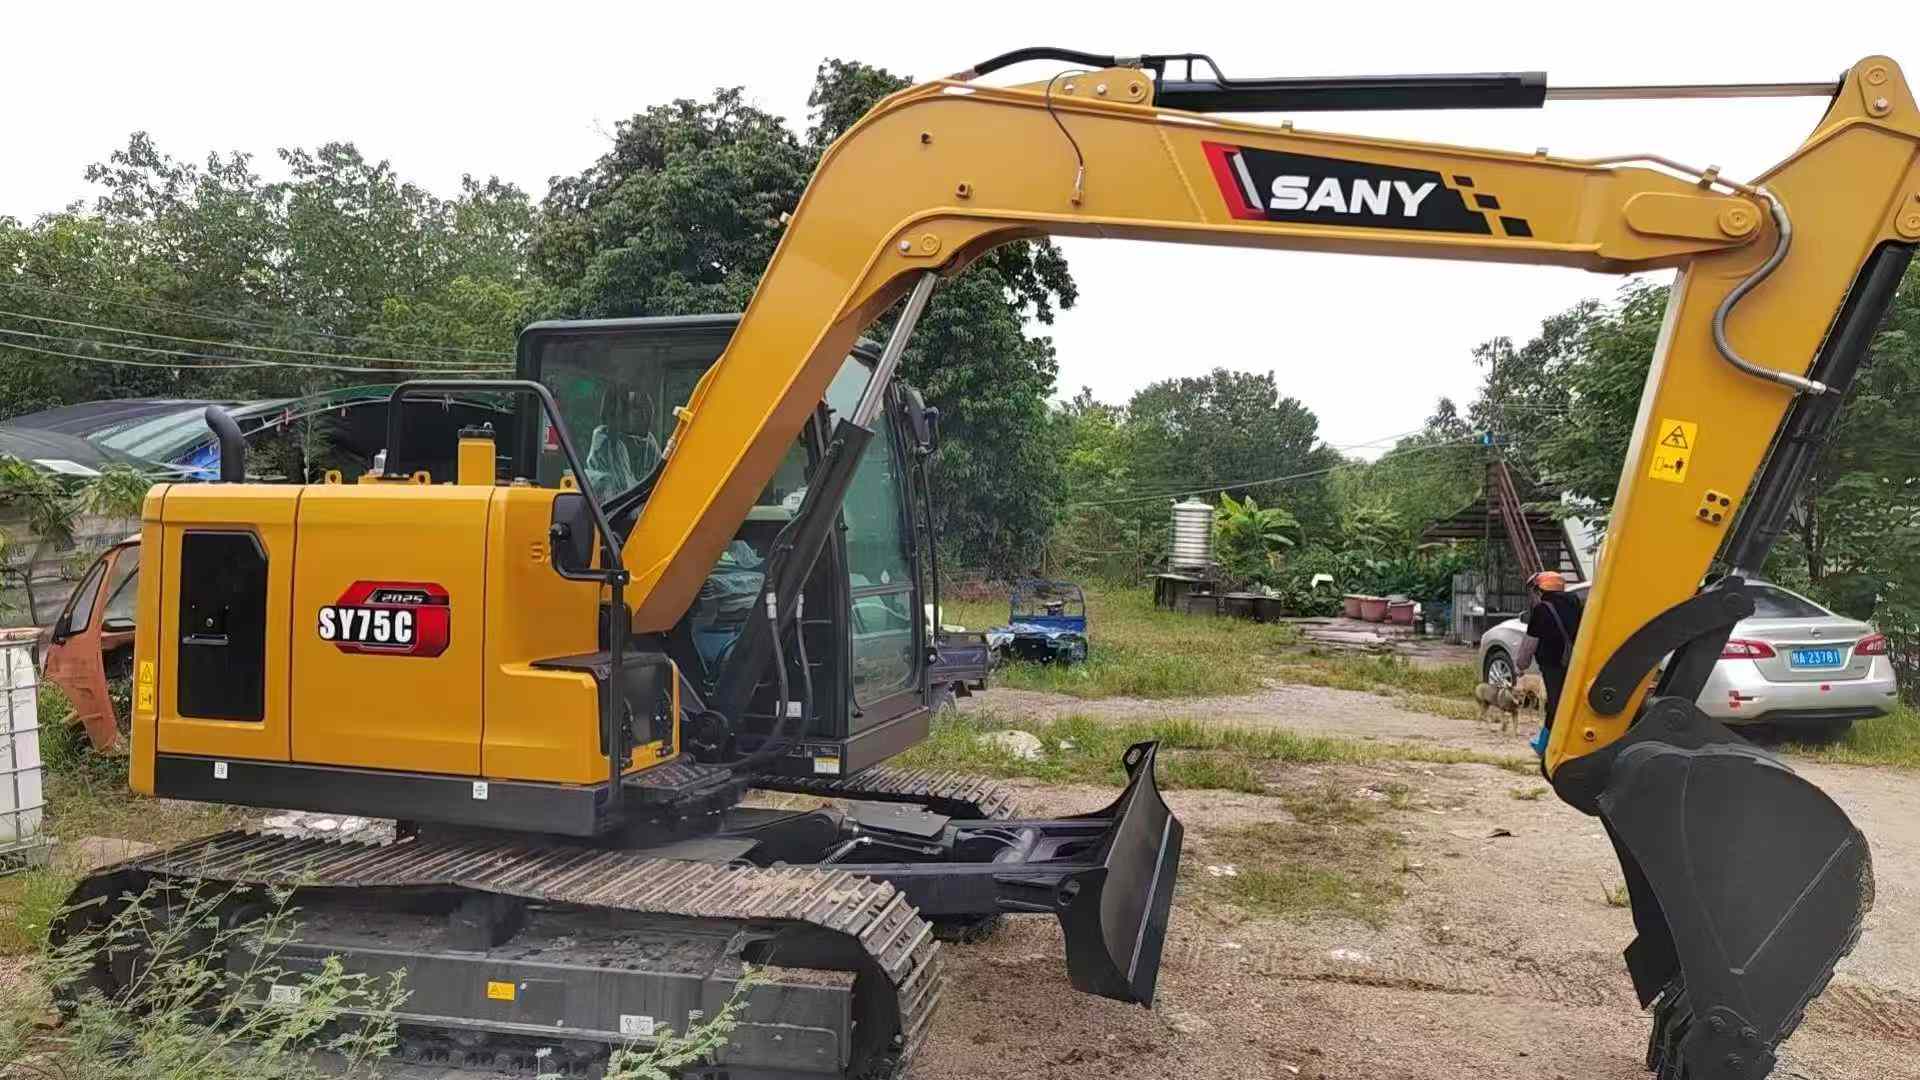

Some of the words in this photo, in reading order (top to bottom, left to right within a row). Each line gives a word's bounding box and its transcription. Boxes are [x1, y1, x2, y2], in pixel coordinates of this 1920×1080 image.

[1270, 175, 1438, 217] SANY
[381, 593, 424, 603] 2025
[319, 607, 412, 642] SY75C
